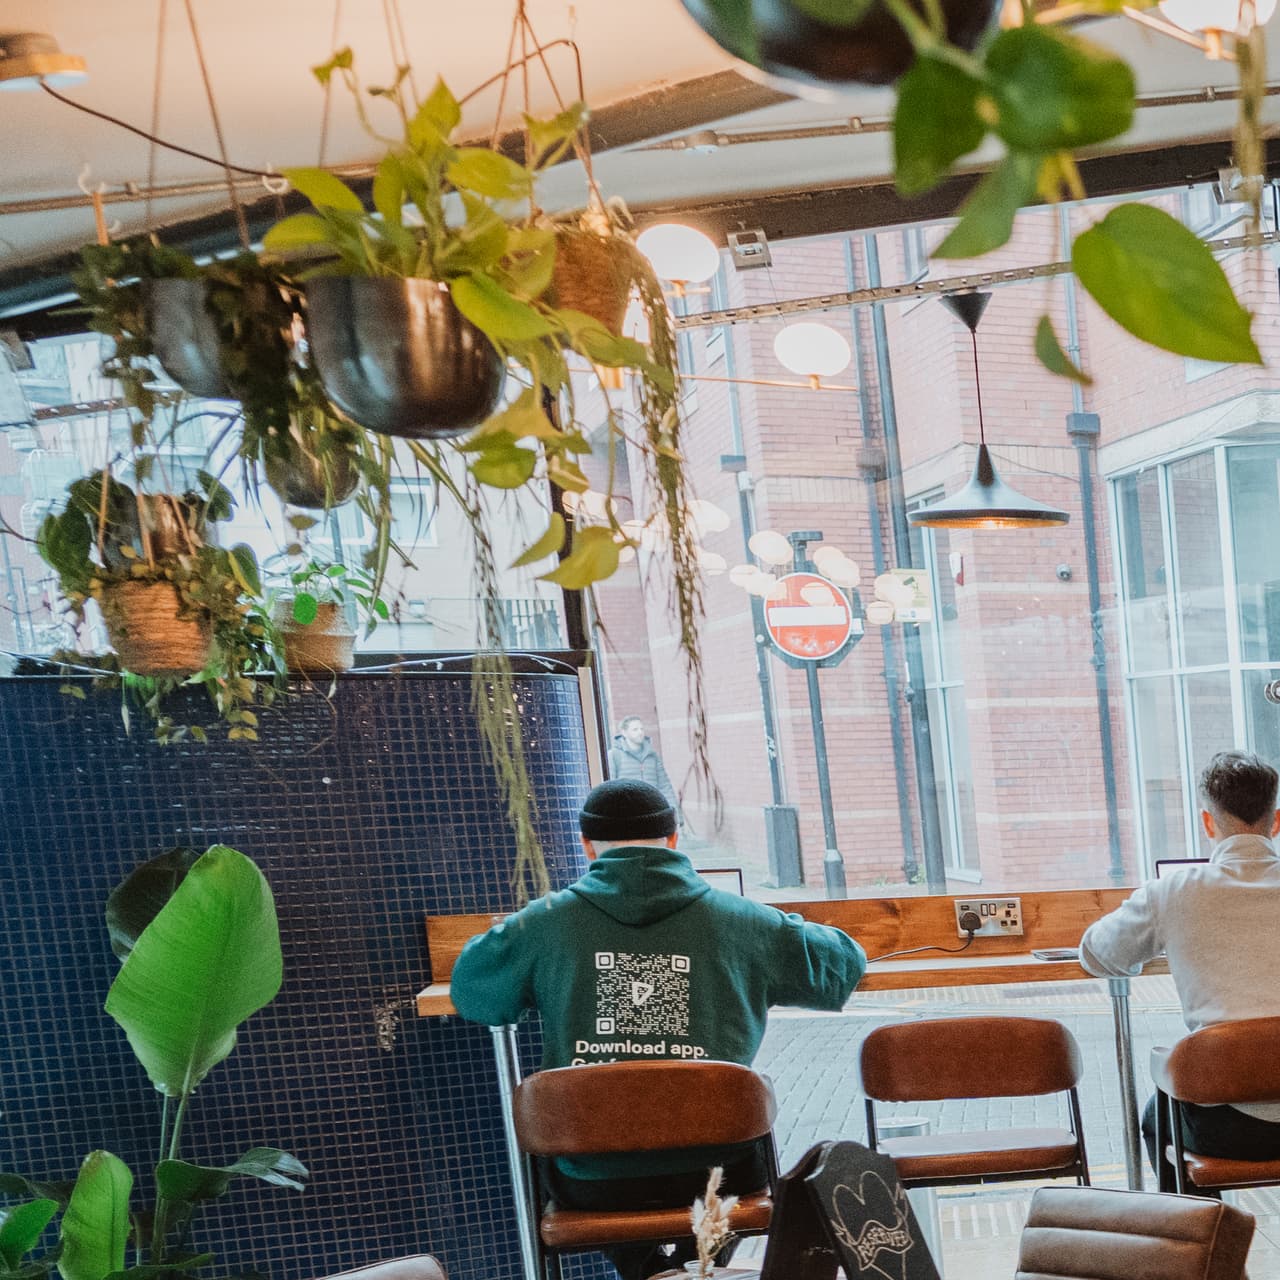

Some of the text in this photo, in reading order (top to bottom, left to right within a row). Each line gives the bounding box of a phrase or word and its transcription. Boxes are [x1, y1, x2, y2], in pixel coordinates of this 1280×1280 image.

[575, 1040, 709, 1059] Download app.
[857, 1226, 909, 1263] RESERVED
